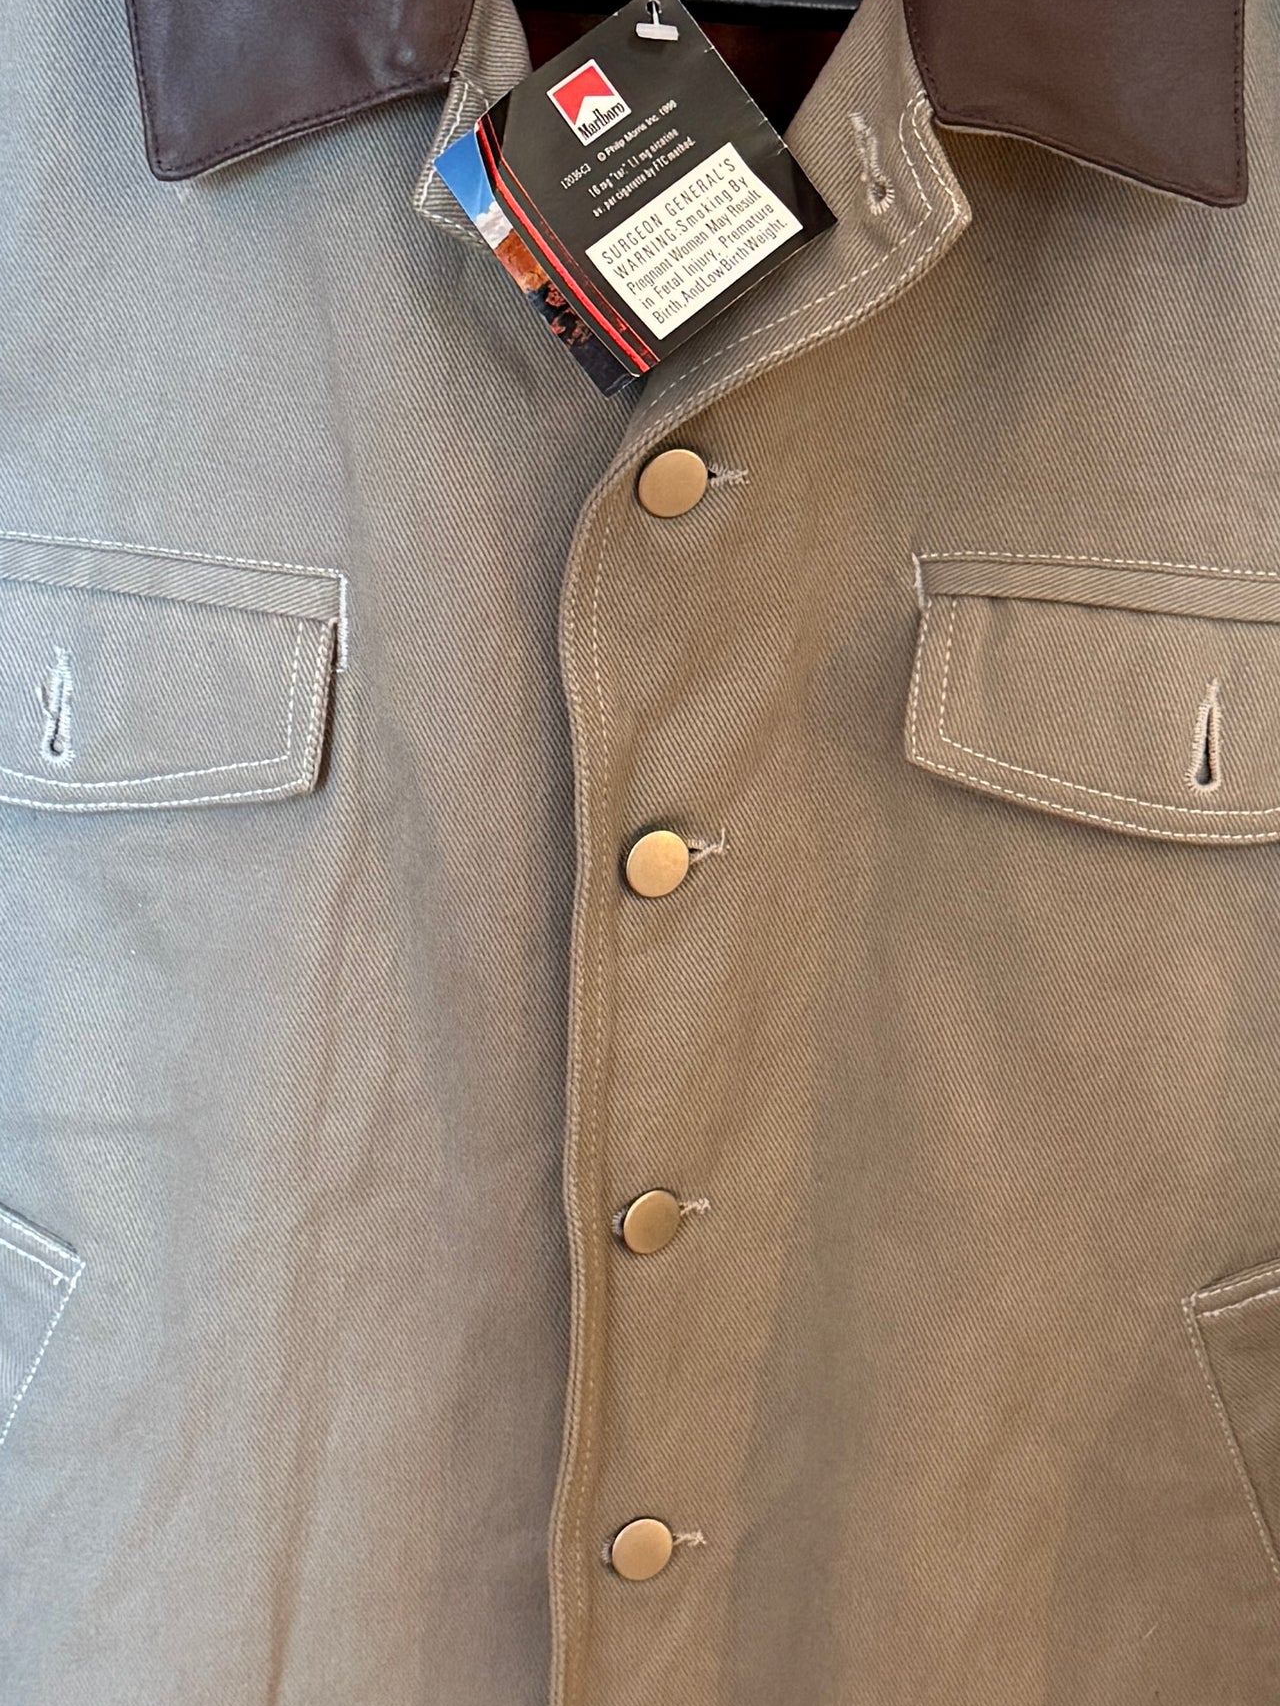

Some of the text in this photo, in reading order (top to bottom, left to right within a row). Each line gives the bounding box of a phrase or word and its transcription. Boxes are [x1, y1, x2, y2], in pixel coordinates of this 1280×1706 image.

[577, 102, 626, 141] Marlboro
[605, 138, 626, 157] Philip
[623, 124, 648, 143] Morris
[616, 173, 648, 201] cigarette
[652, 155, 669, 172] FTC
[728, 176, 750, 194] By
[601, 158, 737, 266] SURGEON GENERAL'S
[626, 259, 674, 297] Pregnant
[705, 214, 733, 235] May
[726, 188, 763, 219] Result
[639, 294, 656, 310] in
[653, 271, 685, 299] Fetal
[718, 204, 775, 249] Premature
